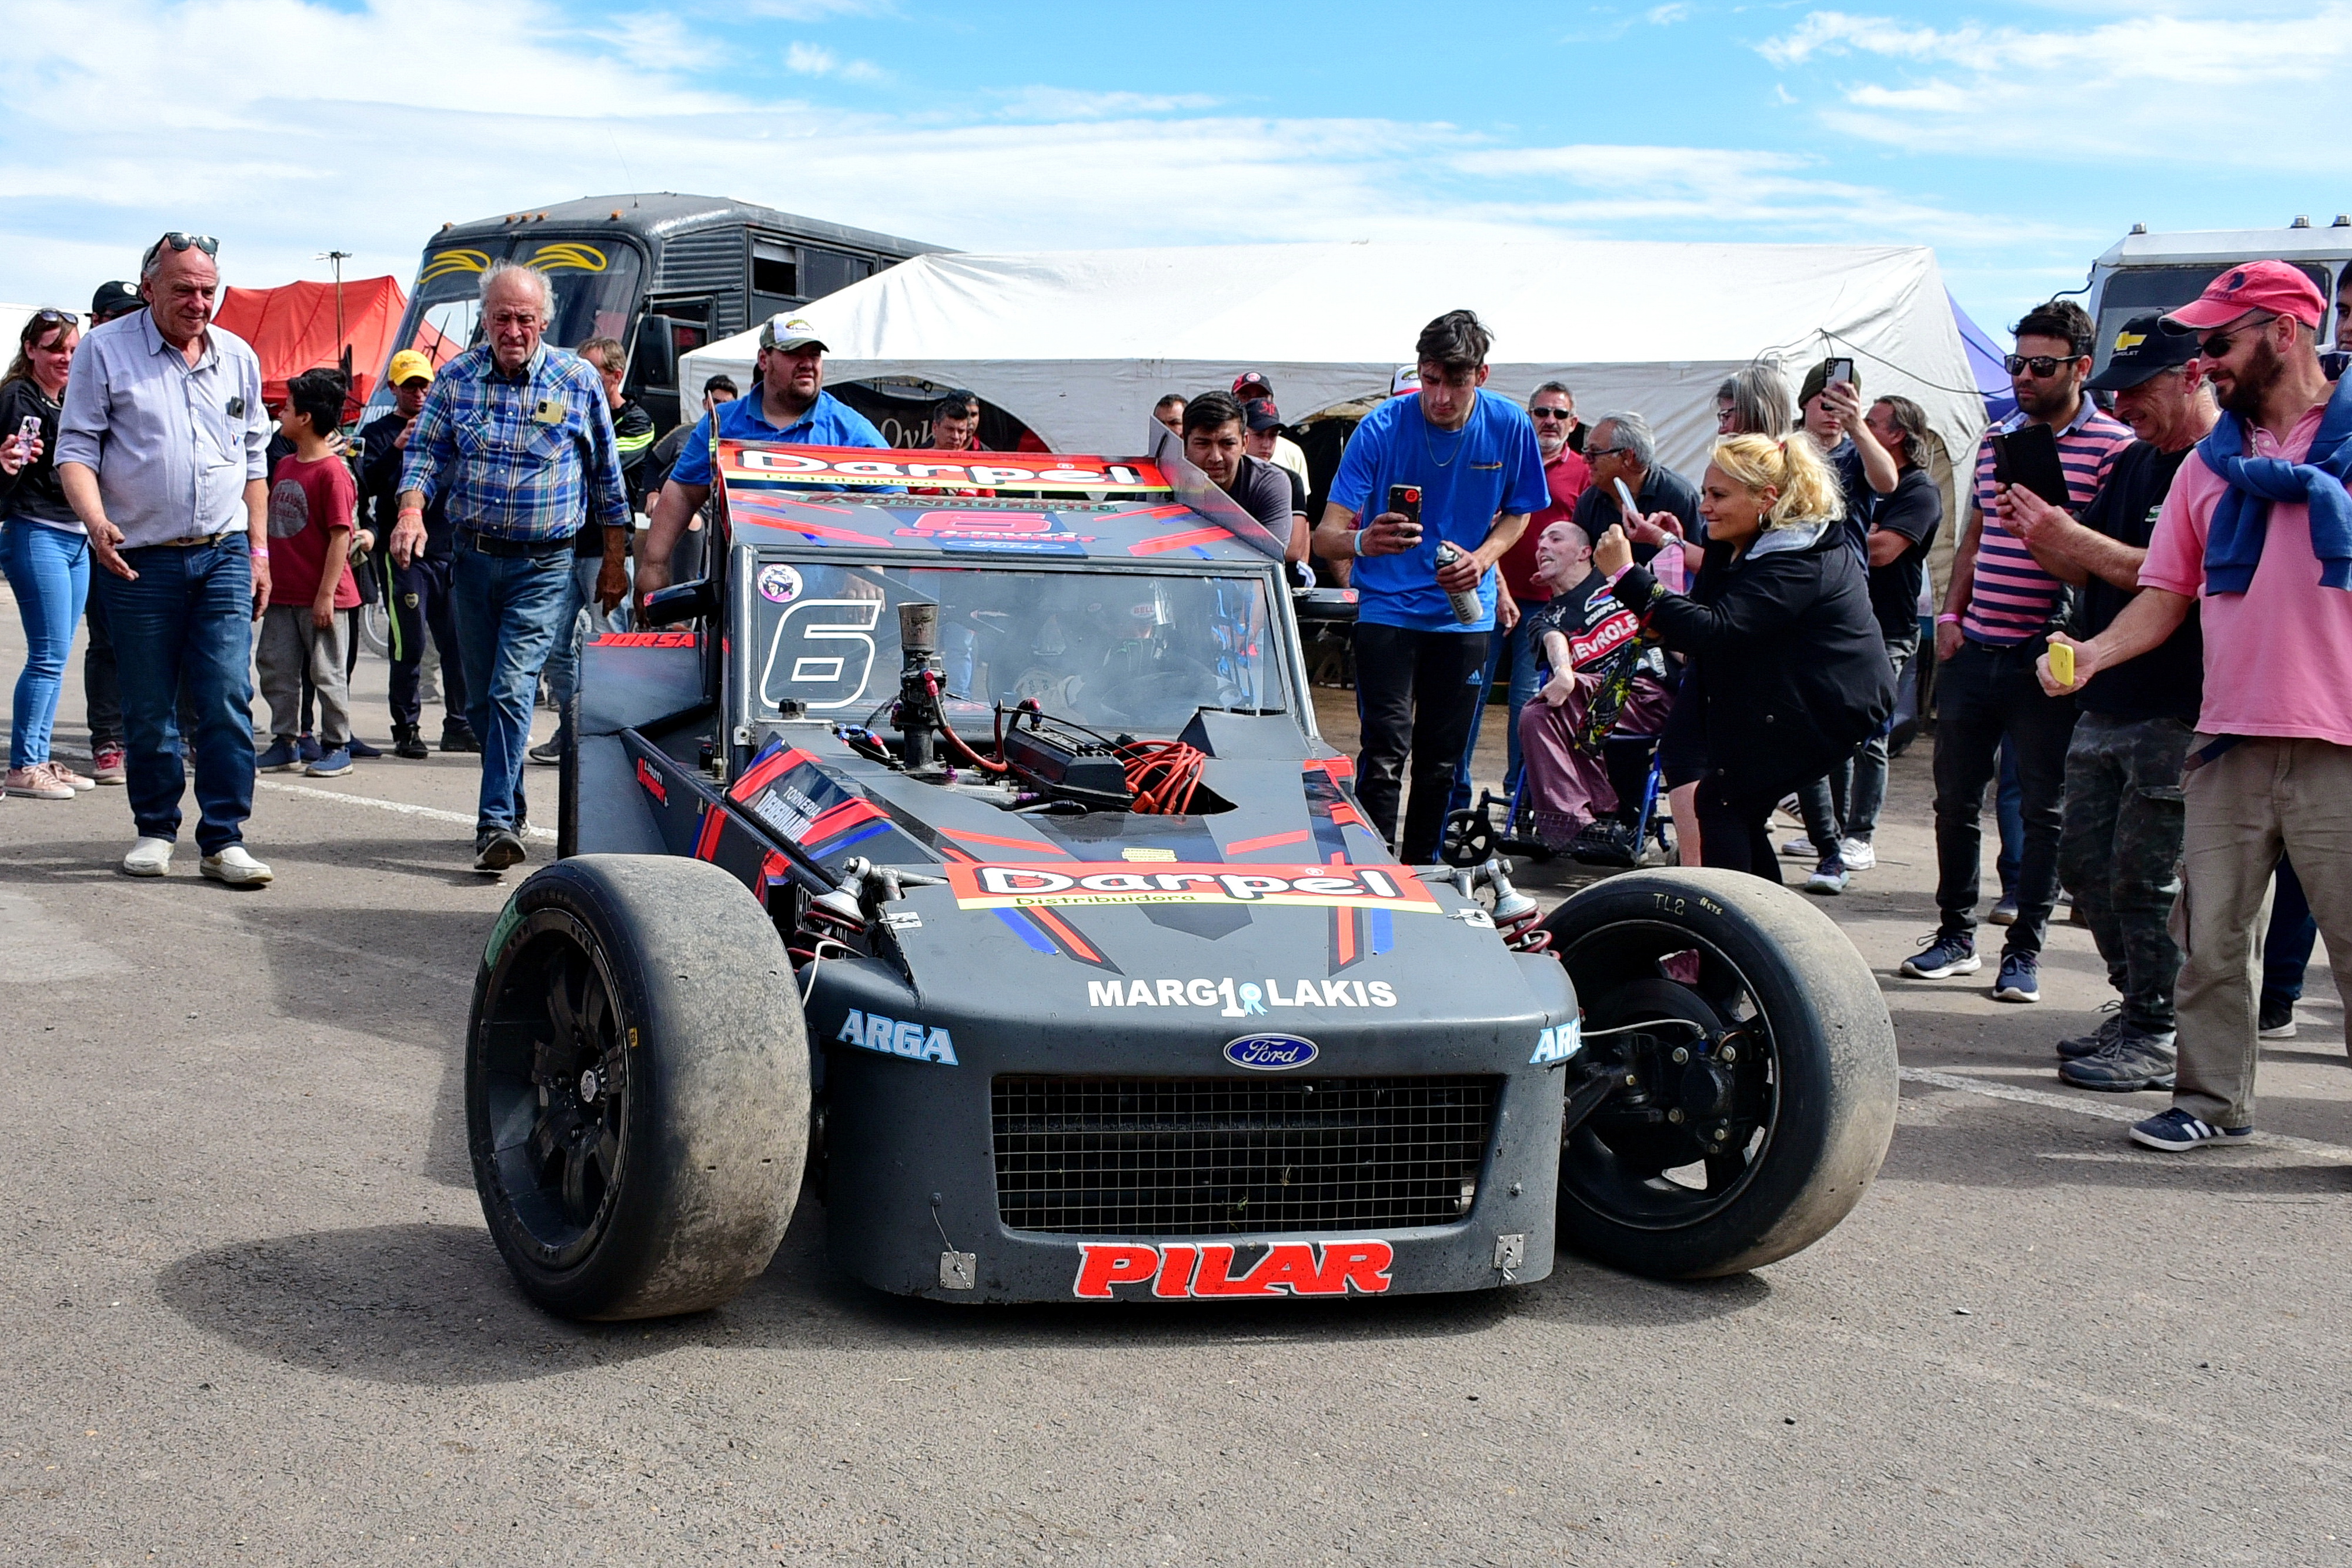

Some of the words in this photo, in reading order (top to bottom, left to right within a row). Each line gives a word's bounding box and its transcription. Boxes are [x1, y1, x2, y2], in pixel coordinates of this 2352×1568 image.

[741, 451, 1136, 484] Darpel
[587, 633, 696, 647] JORSA
[760, 599, 881, 709] 6
[783, 785, 822, 818] TORNERIA
[981, 867, 1397, 900] Darpel
[1015, 895, 1197, 907] Distribuidora
[836, 1008, 959, 1066] ARGA
[1241, 1039, 1300, 1064] Ford
[1528, 1017, 1581, 1064] ARG
[1073, 1238, 1394, 1299] PILAR
